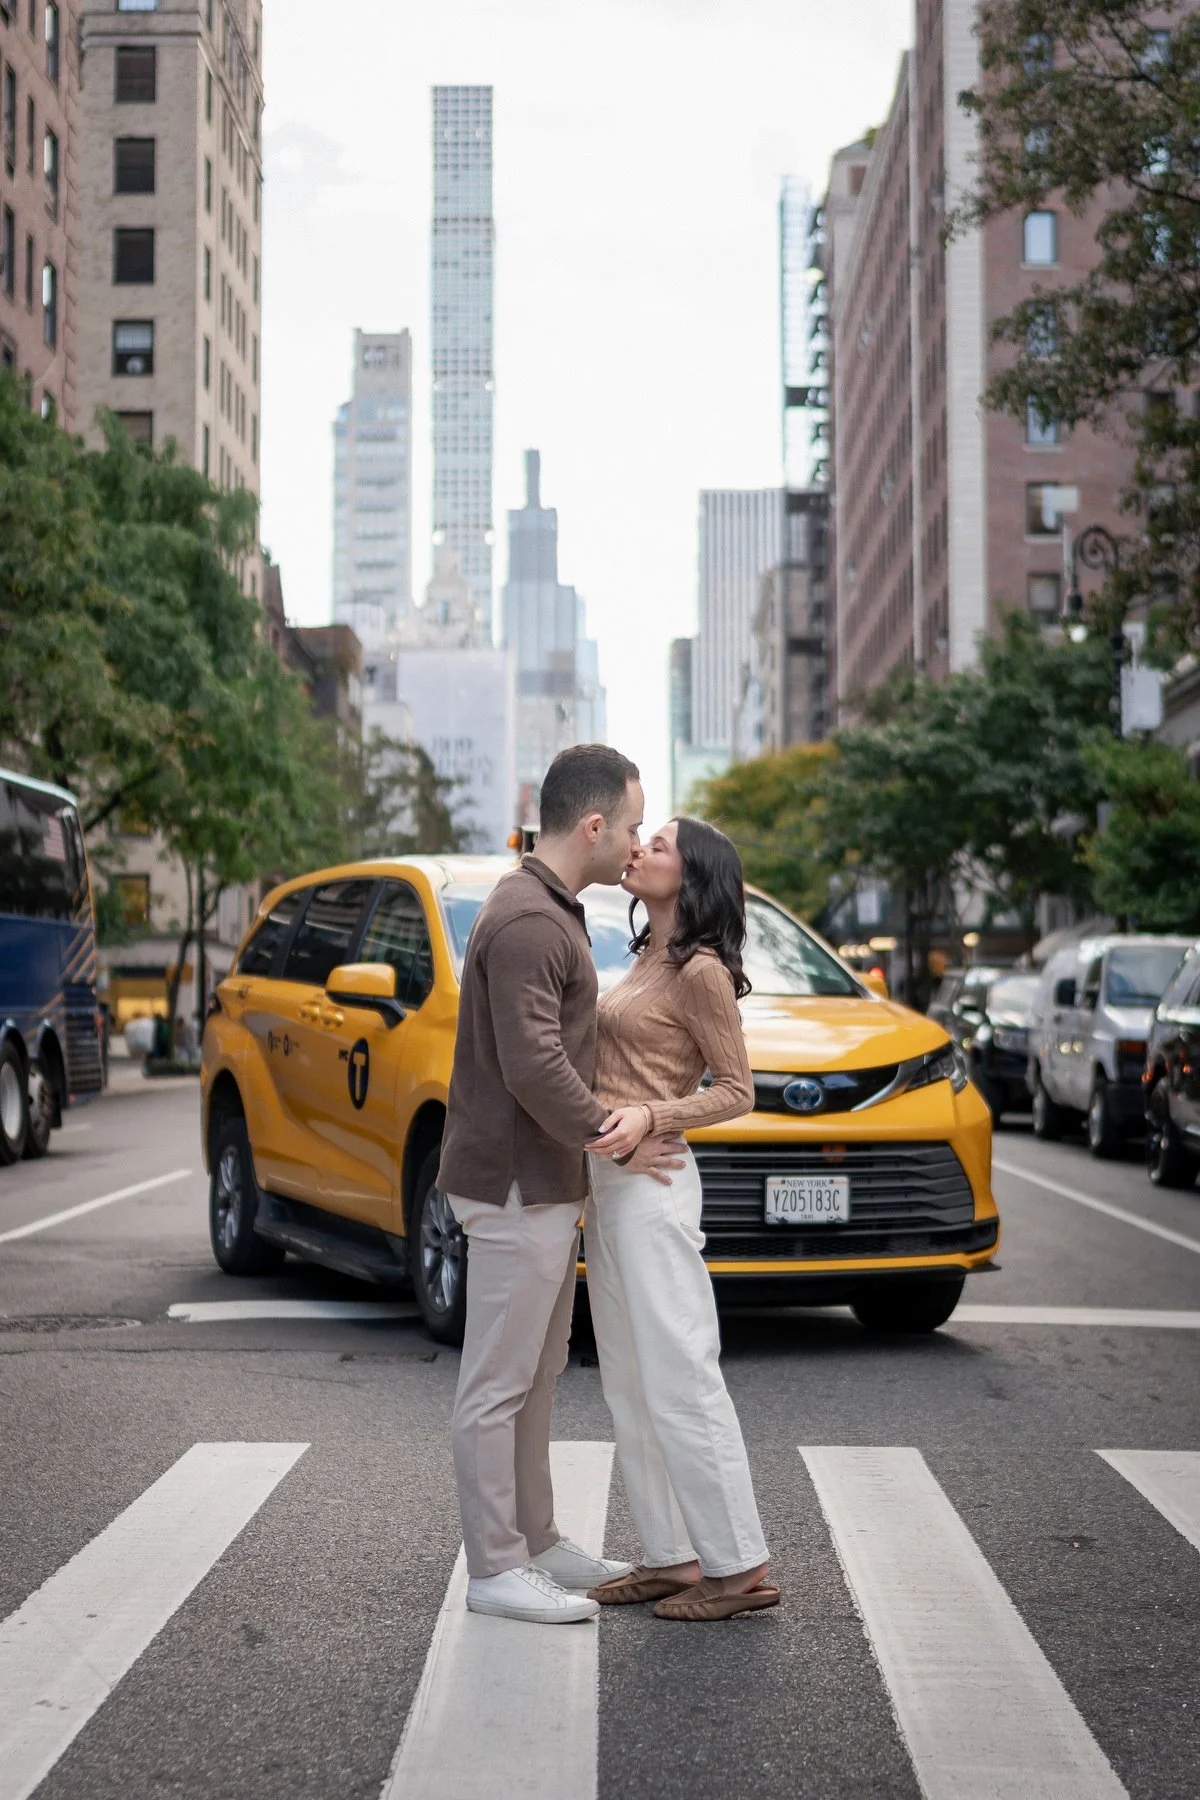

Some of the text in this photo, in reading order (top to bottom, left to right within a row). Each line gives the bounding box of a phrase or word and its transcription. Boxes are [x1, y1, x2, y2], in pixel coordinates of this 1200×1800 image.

[353, 1051, 366, 1101] T
[786, 1179, 828, 1188] NEW YORK
[773, 1189, 840, 1212] Y205183C
